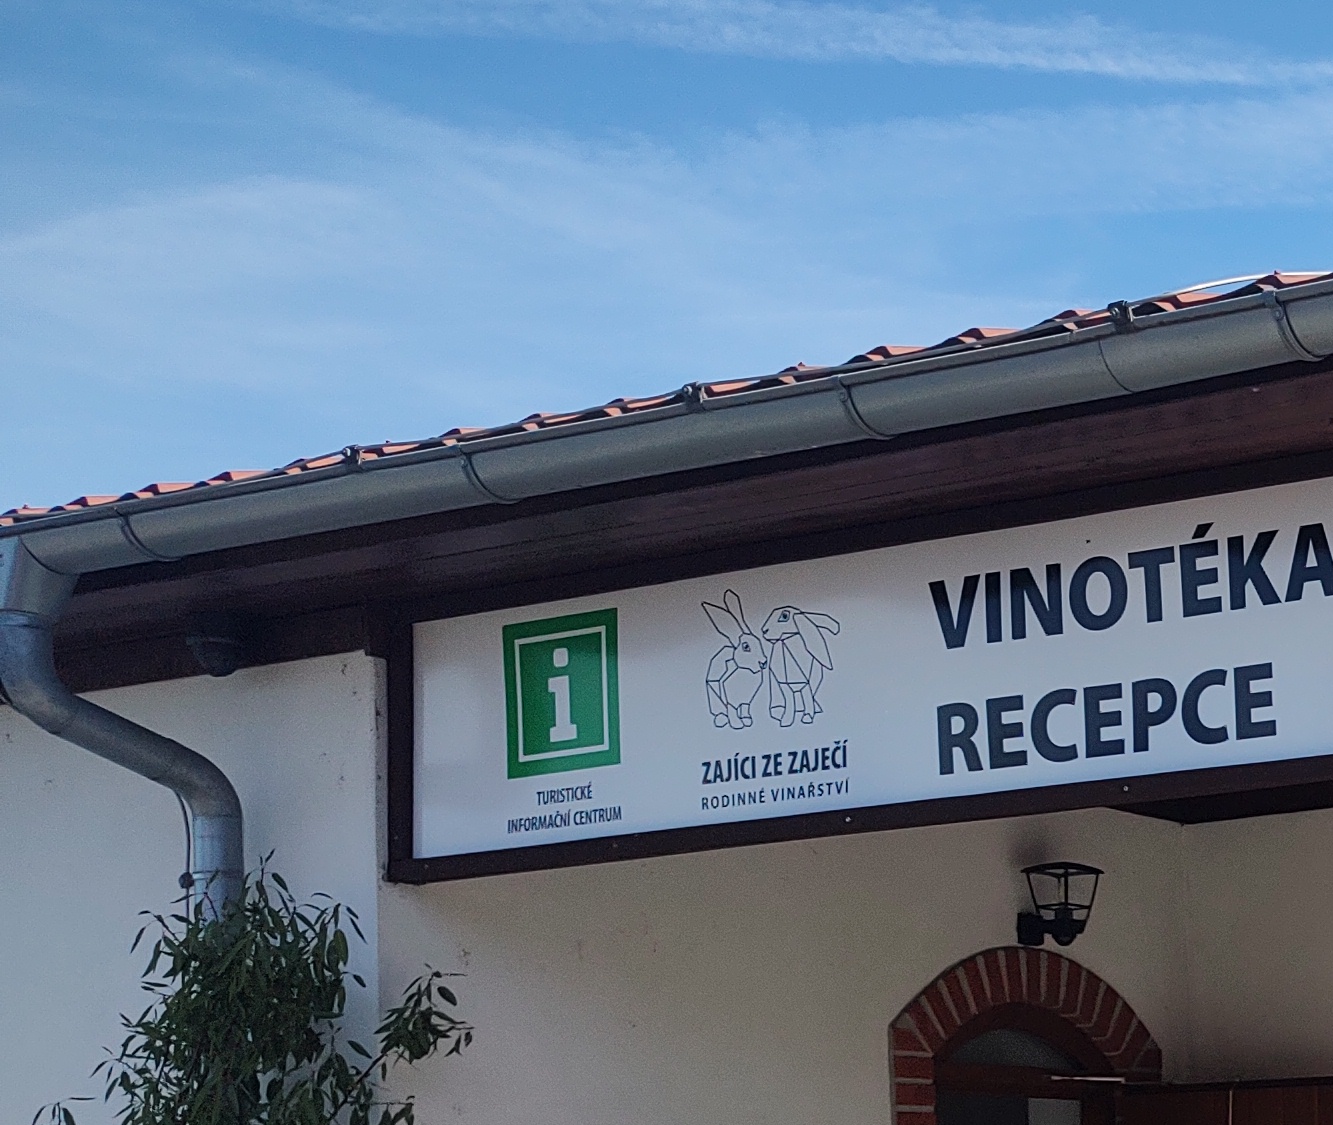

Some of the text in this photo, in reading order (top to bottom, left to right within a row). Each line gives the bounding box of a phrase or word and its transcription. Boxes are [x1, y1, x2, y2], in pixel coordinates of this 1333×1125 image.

[937, 662, 1277, 775] RECEPCE
[701, 739, 848, 785] ZAJÍCI ZE ZAJEČÍ
[536, 781, 593, 806] TURISTICKÉ
[701, 776, 850, 810] RODINNÉ VINAŘSTVÍ
[507, 805, 622, 834] INFORMAČNÍ CENTRUM
